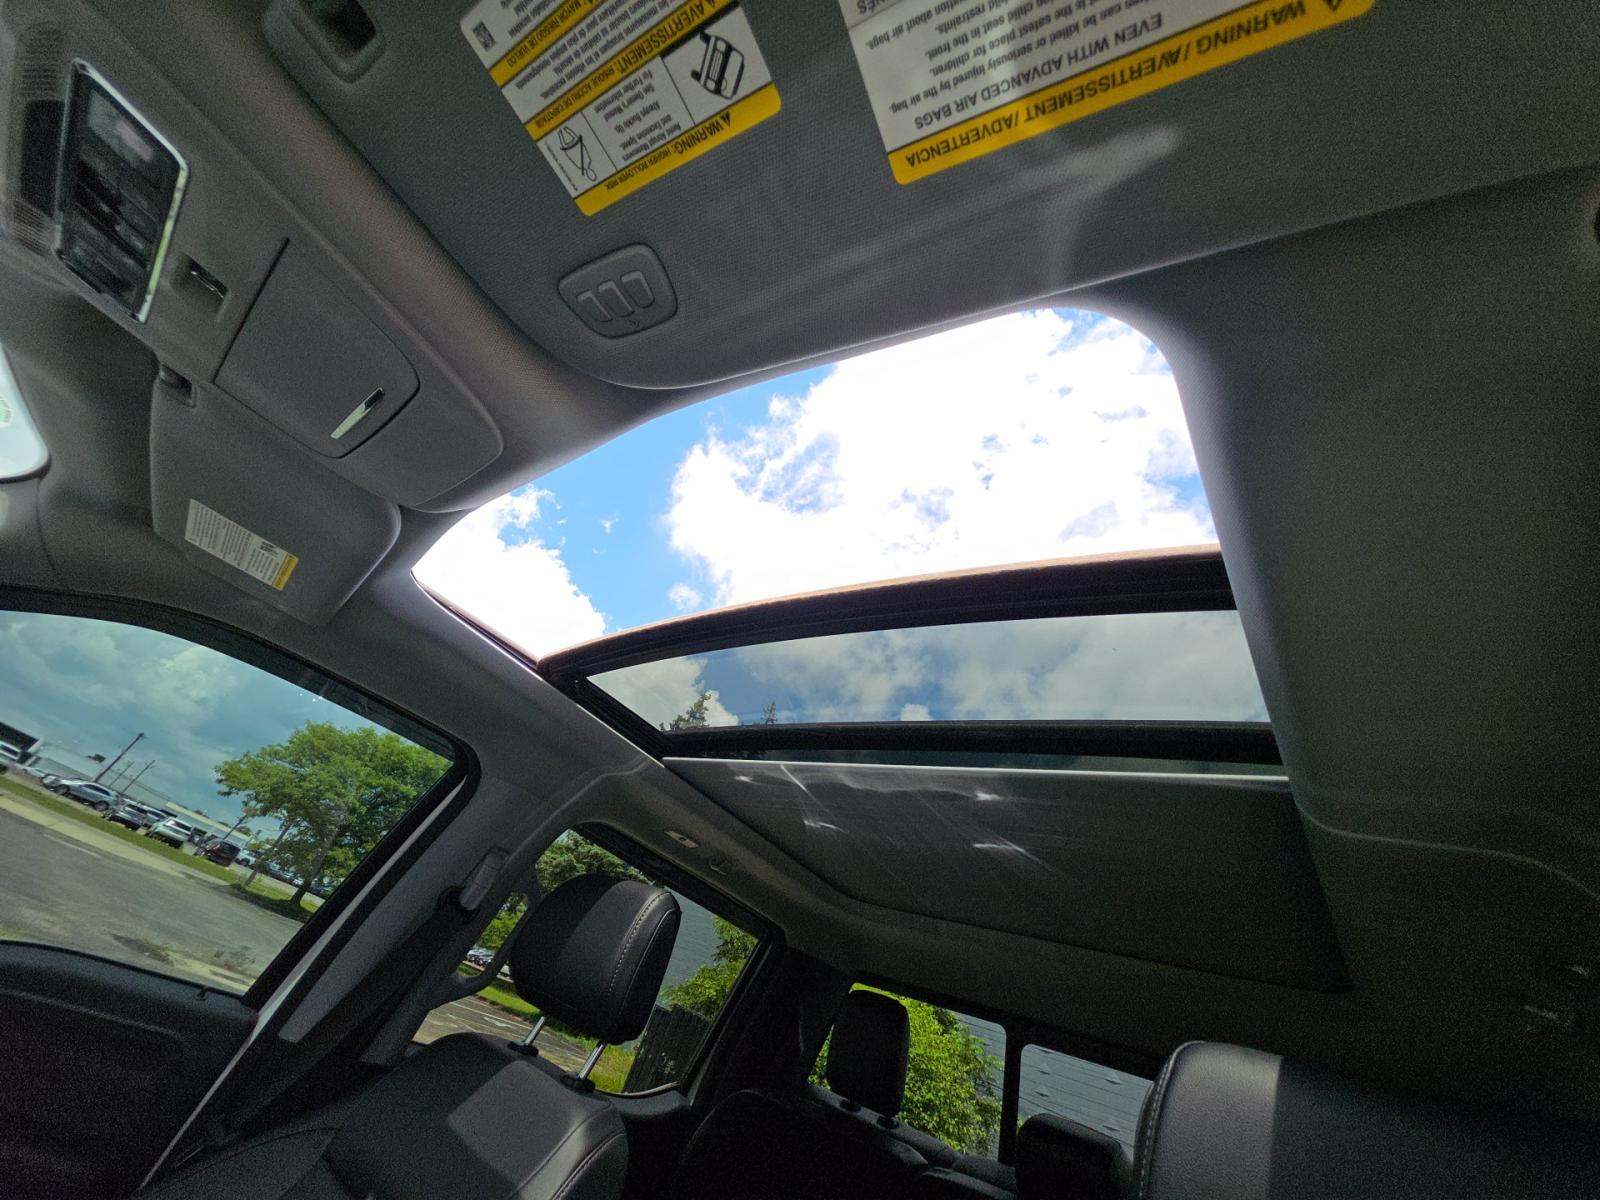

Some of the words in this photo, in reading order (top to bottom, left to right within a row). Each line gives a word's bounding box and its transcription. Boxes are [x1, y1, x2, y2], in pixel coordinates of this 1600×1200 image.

[904, 8, 932, 32] about
[1006, 1, 1031, 23] child
[1054, 4, 1071, 22] the
[1080, 13, 1097, 30] be
[1100, 2, 1123, 21] can
[891, 23, 904, 39] air
[970, 27, 980, 40] in
[981, 15, 1004, 34] seat
[1018, 13, 1050, 38] safest
[1050, 20, 1078, 46] killed
[1114, 11, 1161, 46] EVEN
[1196, 2, 1305, 55] WARNING
[951, 33, 968, 49] the
[988, 27, 1015, 51] place
[1035, 37, 1046, 49] or
[972, 44, 986, 60] for
[988, 43, 1033, 72] seriously
[1066, 35, 1109, 66] WITH
[951, 62, 987, 89] injured
[979, 54, 1061, 101] ADVANCED
[922, 84, 939, 102] the
[939, 78, 953, 95] by
[908, 92, 923, 108] air
[953, 91, 975, 112] AIR
[913, 102, 951, 130] BAGS
